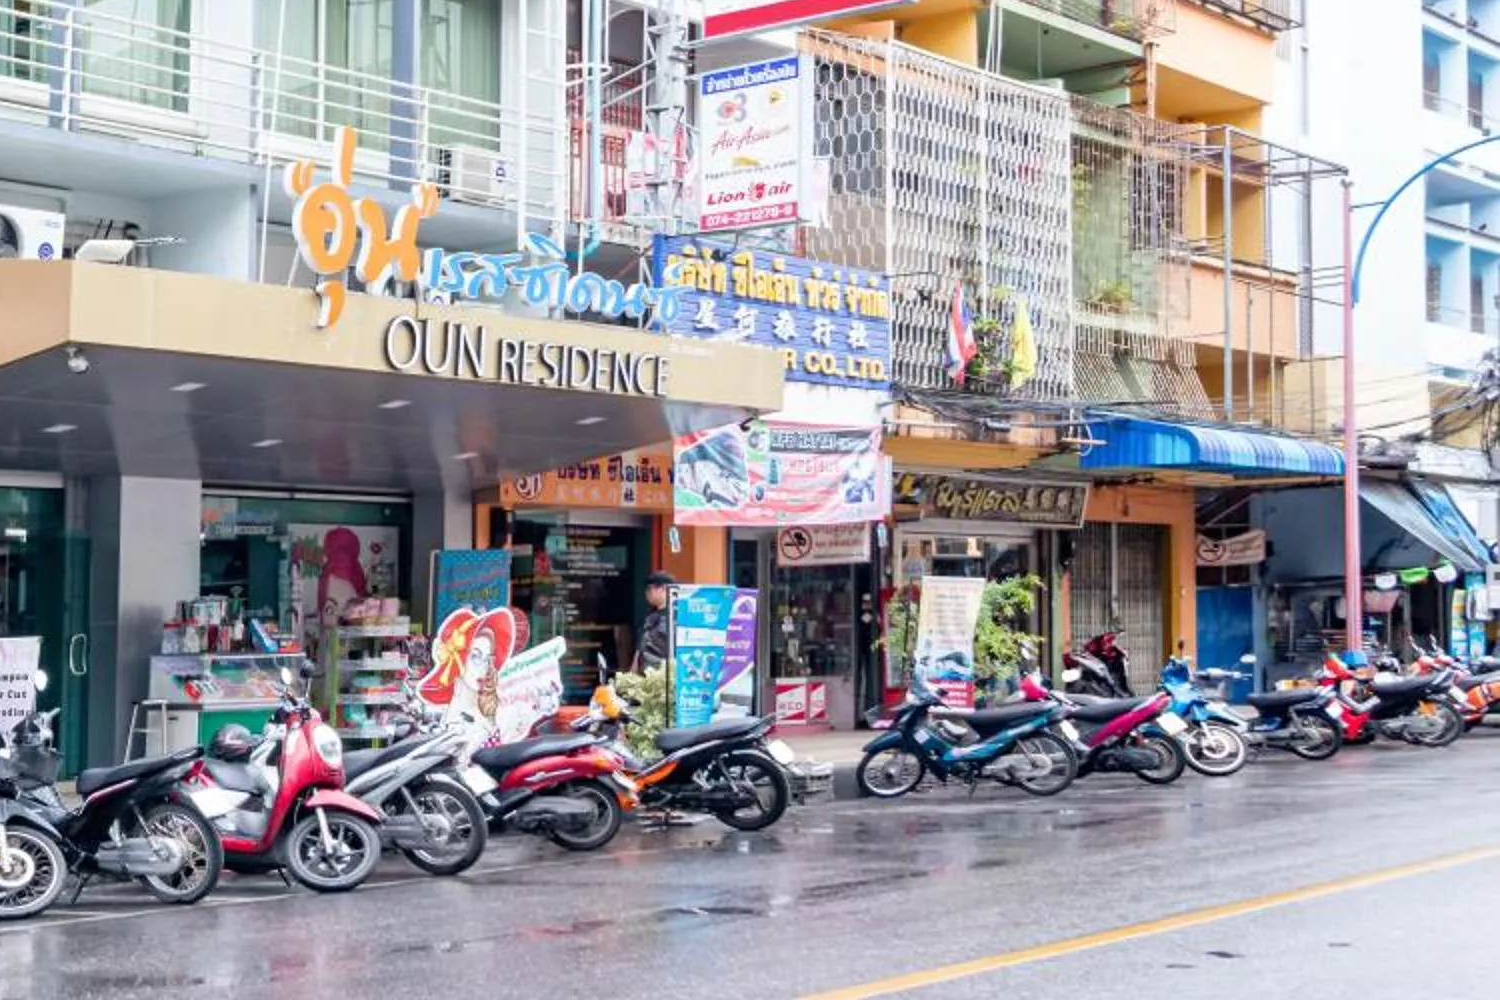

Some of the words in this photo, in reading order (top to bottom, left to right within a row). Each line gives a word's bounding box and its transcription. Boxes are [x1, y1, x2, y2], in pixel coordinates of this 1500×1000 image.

[707, 188, 746, 206] Lion
[767, 180, 793, 197] air
[385, 313, 486, 379] OUN
[500, 337, 669, 397] RESIDENCE
